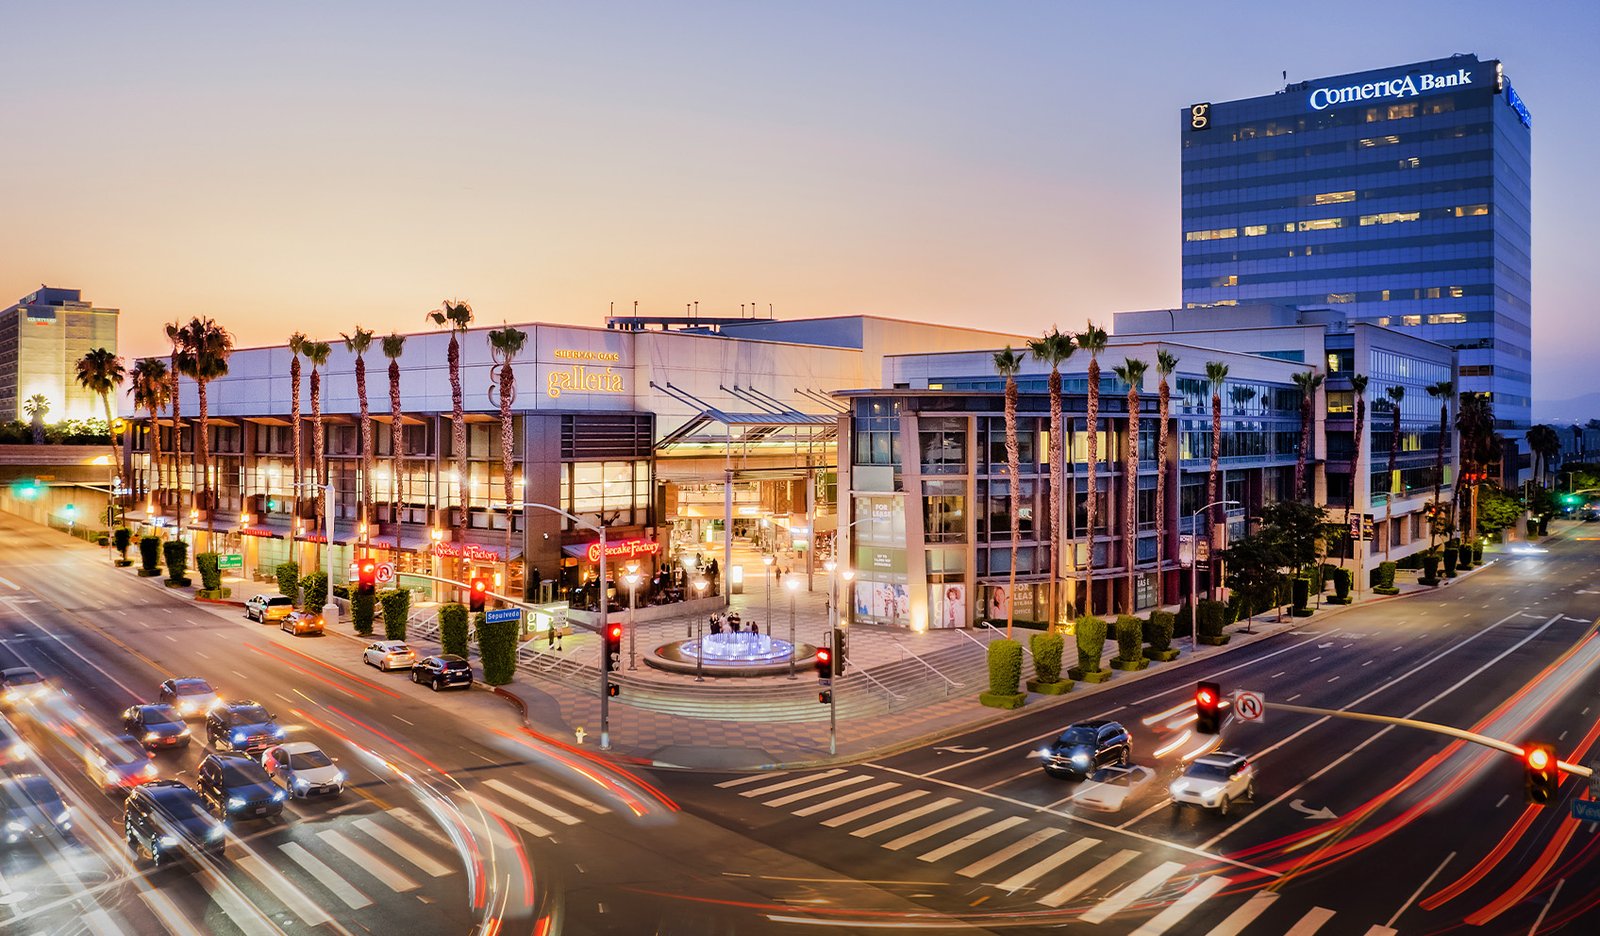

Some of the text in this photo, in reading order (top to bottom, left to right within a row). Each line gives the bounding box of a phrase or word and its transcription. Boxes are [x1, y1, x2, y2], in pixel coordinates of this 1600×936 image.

[1420, 69, 1472, 91] Bank
[1192, 104, 1208, 128] g
[547, 365, 624, 398] galleria
[467, 545, 498, 561] Factory
[588, 540, 659, 561] Chesecake Factory
[487, 610, 520, 621] Sepulveda
